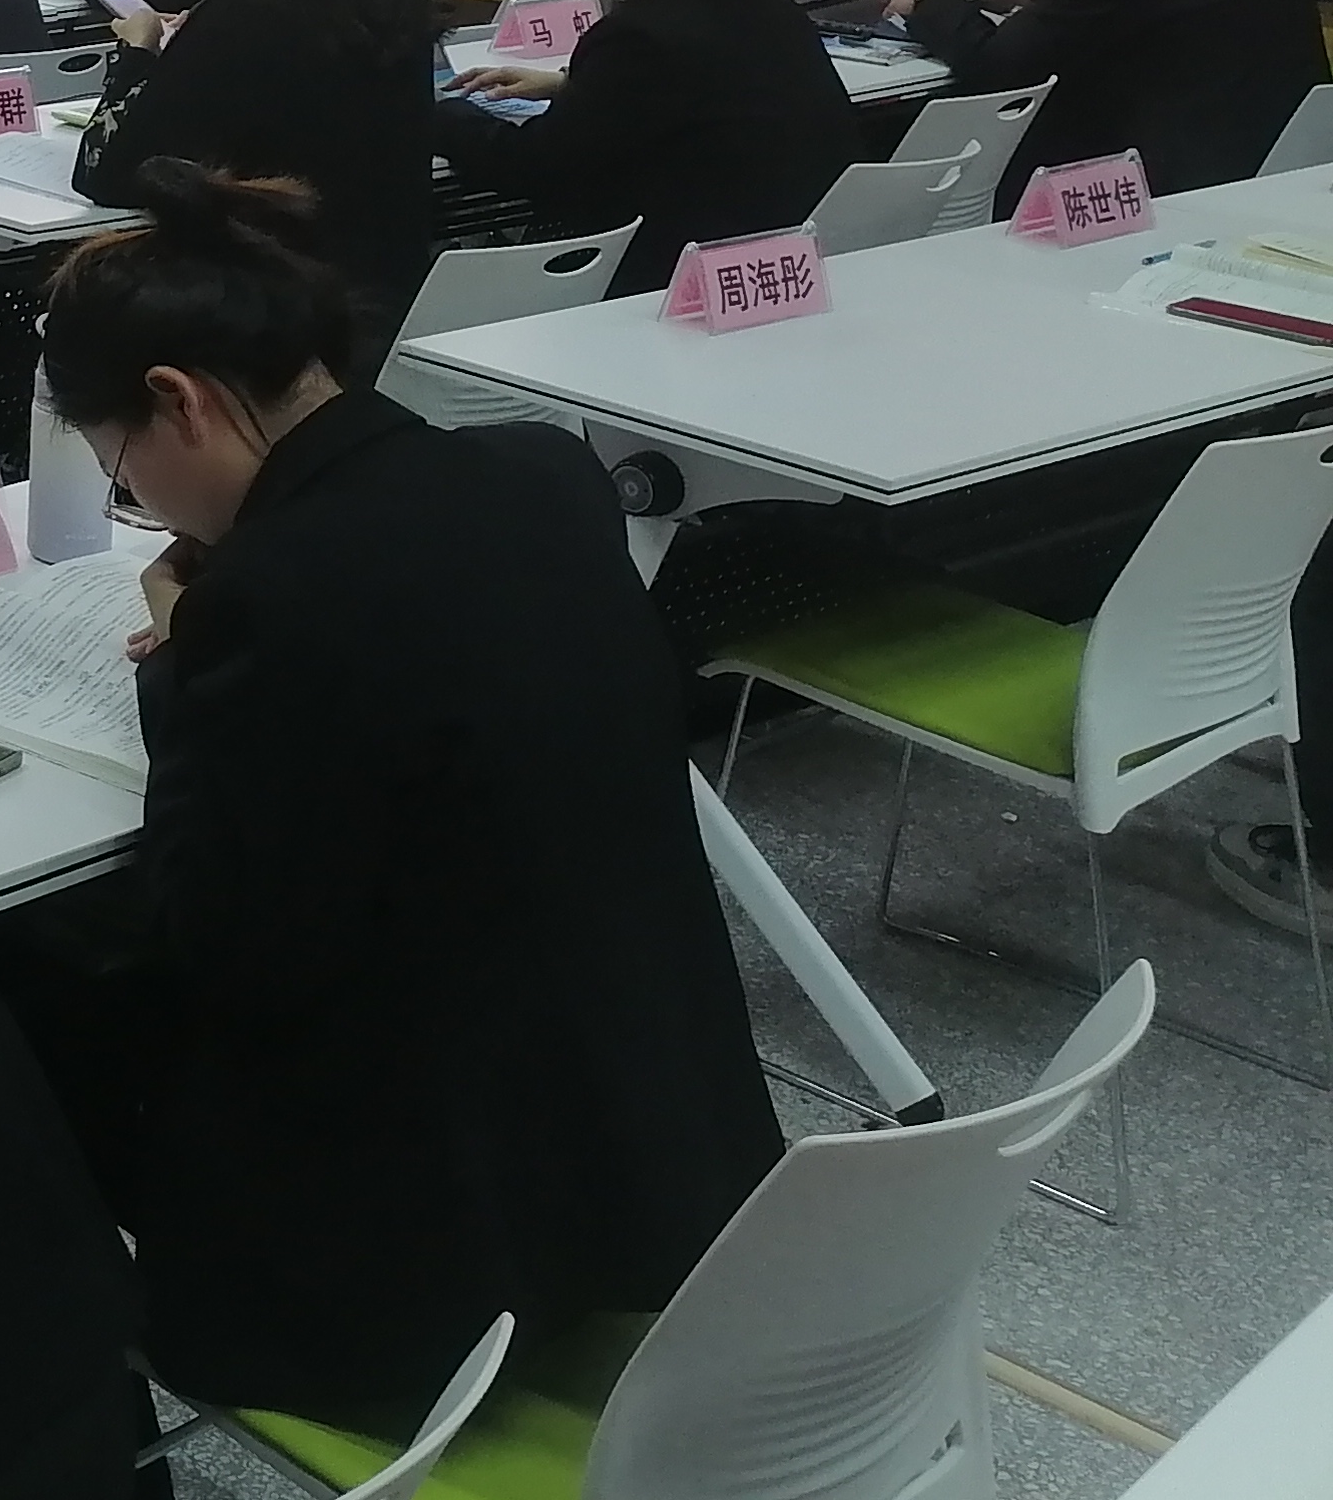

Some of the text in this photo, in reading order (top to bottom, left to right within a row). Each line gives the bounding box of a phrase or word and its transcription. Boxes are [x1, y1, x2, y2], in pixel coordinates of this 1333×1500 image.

[529, 18, 552, 47] 马
[1064, 174, 1143, 232] 陈世伟
[717, 251, 816, 315] 周海彤
